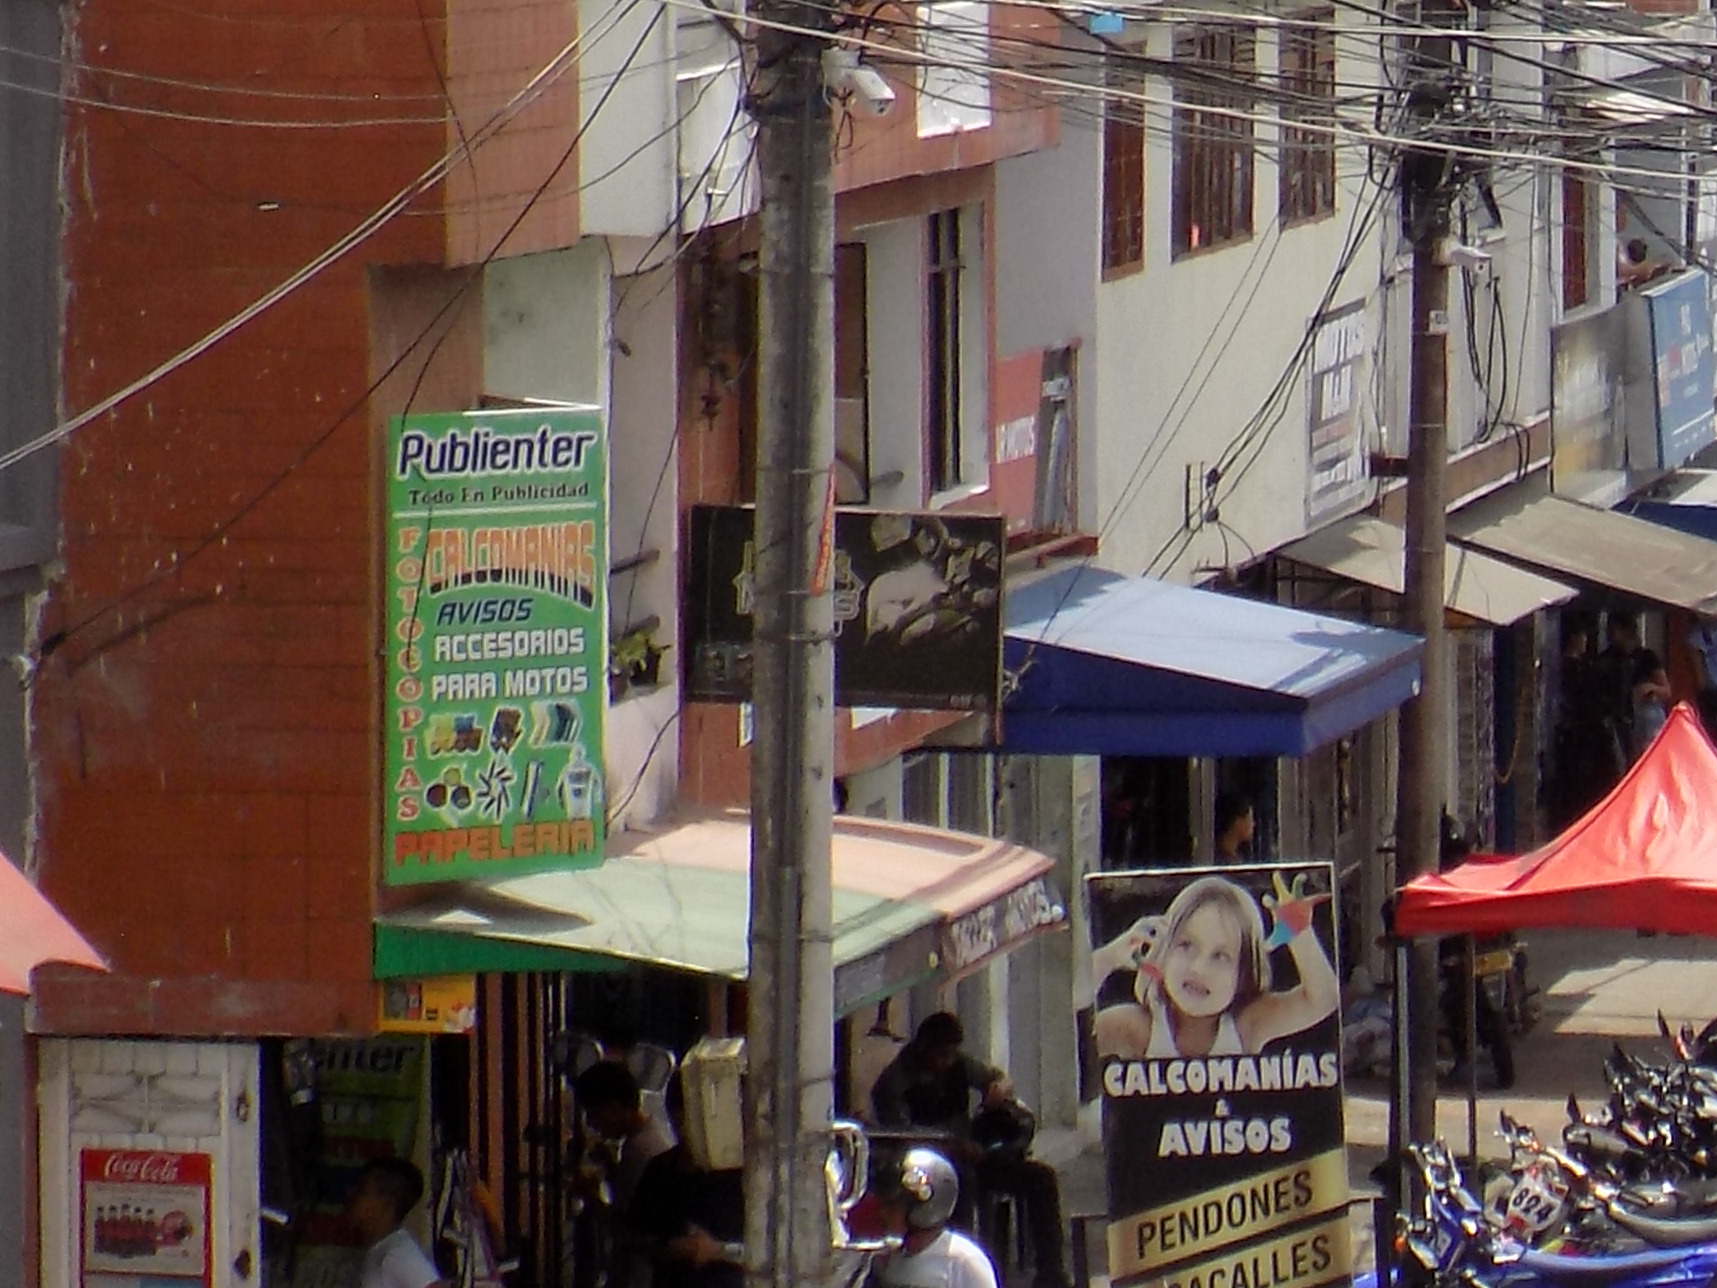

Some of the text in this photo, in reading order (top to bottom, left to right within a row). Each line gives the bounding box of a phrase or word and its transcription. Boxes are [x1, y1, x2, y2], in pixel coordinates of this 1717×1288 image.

[398, 425, 597, 480] Publienter
[409, 482, 588, 506] Todo En Publicidad
[427, 519, 596, 609] CALCOMANIAS
[437, 598, 534, 626] AVISOS
[434, 626, 586, 662] ACCESORIOS
[396, 526, 424, 822] FOTOCOPIAS
[432, 665, 589, 702] PARA MOTOS
[394, 819, 594, 866] PAPELERIA
[1103, 1048, 1340, 1098] CALCOMANÍAS
[1214, 1097, 1231, 1117] &
[1157, 1116, 1293, 1157] AVISOS
[1136, 1169, 1314, 1261] PENDONES
